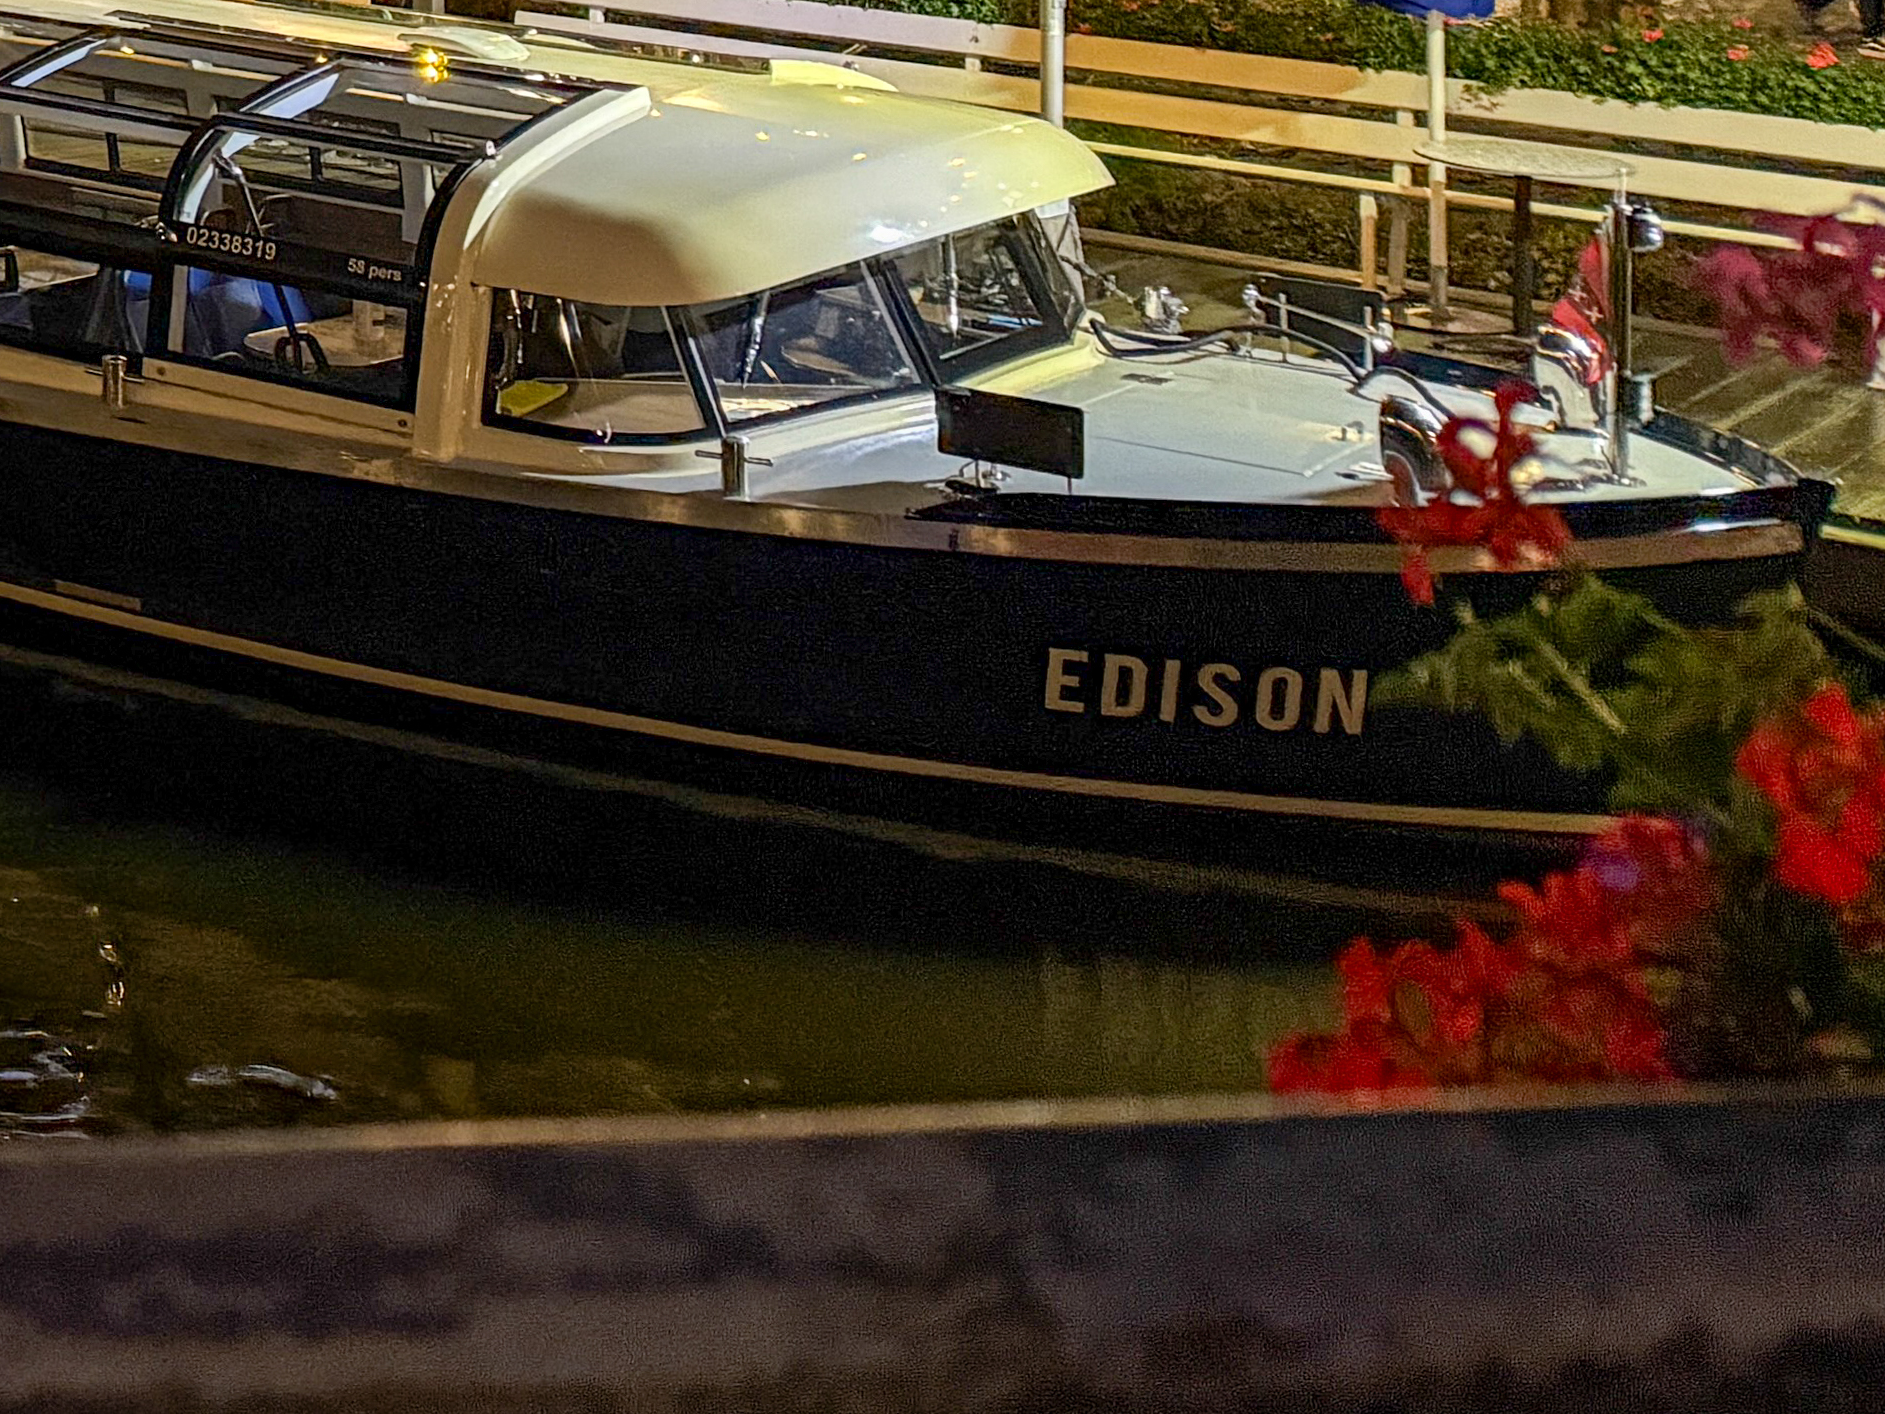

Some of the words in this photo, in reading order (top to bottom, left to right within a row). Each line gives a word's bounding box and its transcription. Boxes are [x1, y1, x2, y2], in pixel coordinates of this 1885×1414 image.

[186, 226, 276, 261] 02338319
[368, 265, 402, 282] pers
[1043, 646, 1369, 736] EDISON
